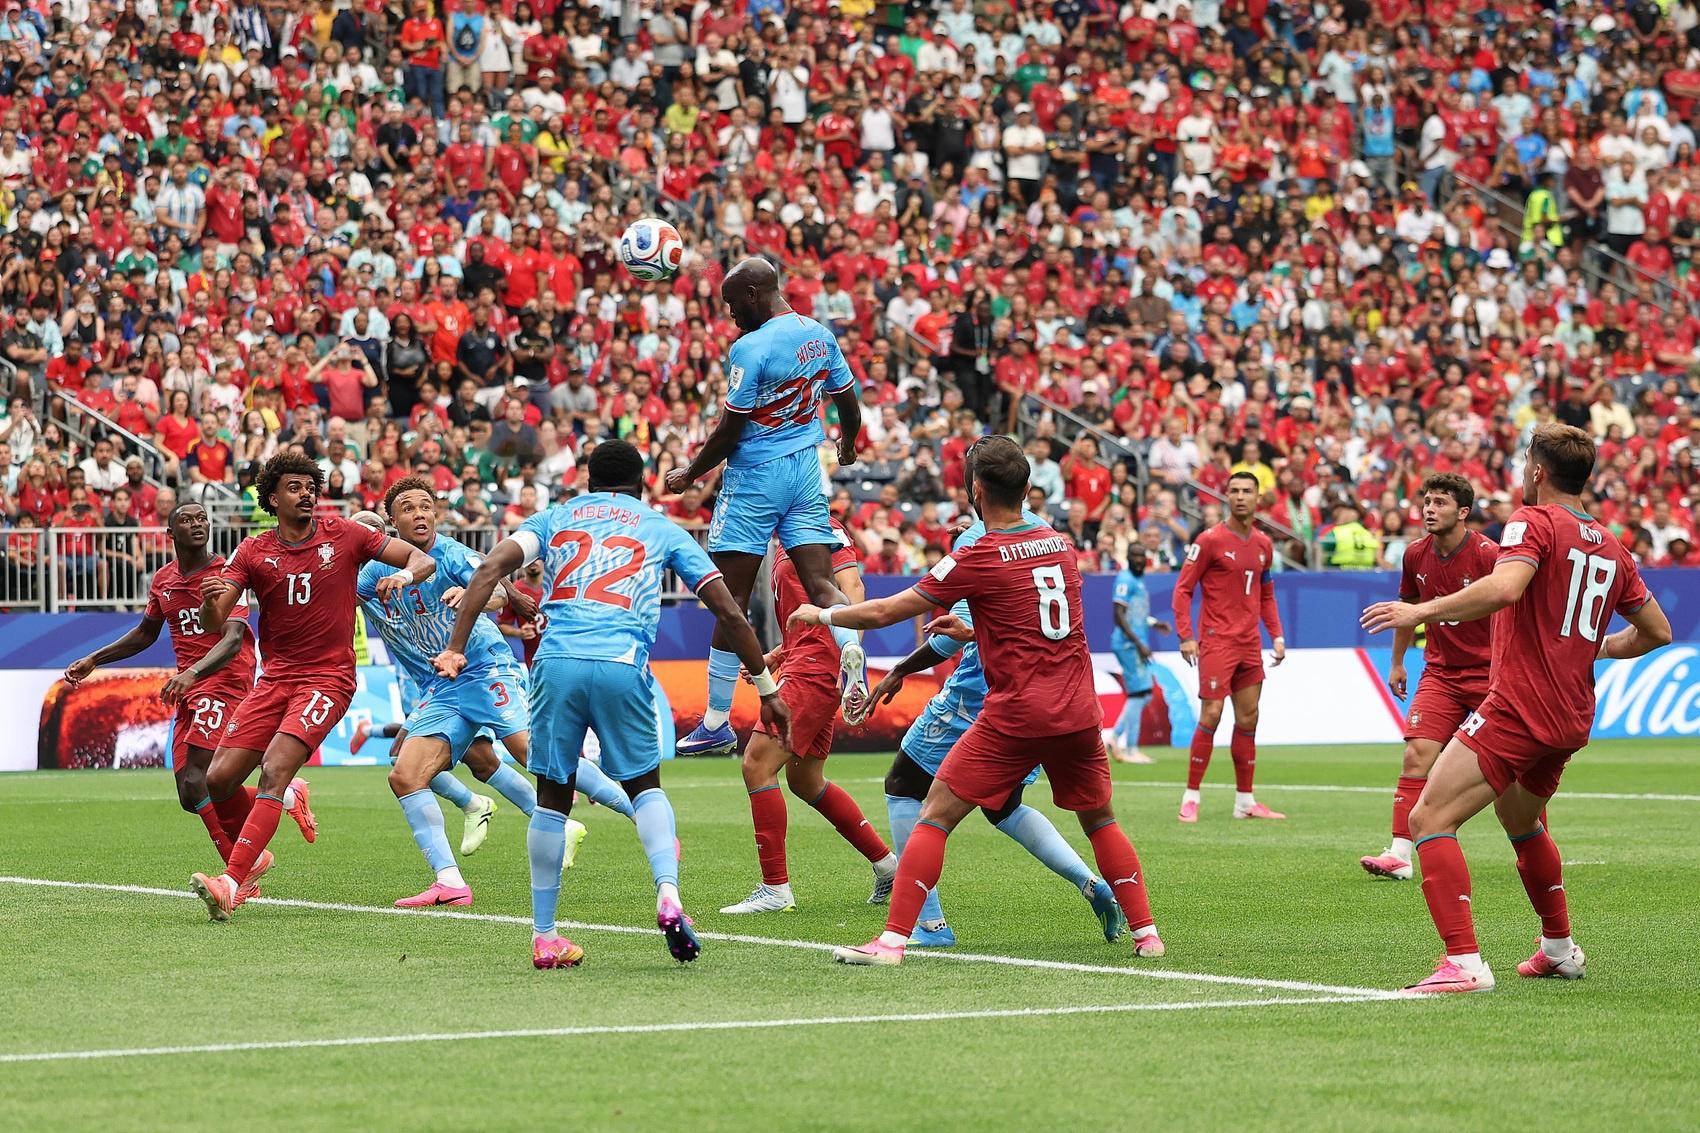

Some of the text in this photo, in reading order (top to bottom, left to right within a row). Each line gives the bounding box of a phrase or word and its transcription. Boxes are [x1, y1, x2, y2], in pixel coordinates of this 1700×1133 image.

[796, 339, 828, 366] WISSA
[573, 505, 641, 529] MBEMBA
[548, 529, 646, 612] 22
[1244, 569, 1255, 596] 7
[286, 572, 313, 606] 13
[409, 588, 427, 616] 3
[1031, 563, 1072, 642] 8
[1559, 547, 1617, 643] 18
[178, 607, 206, 637] 25
[301, 689, 336, 726] 13
[488, 680, 511, 708] 3
[193, 696, 227, 731] 25
